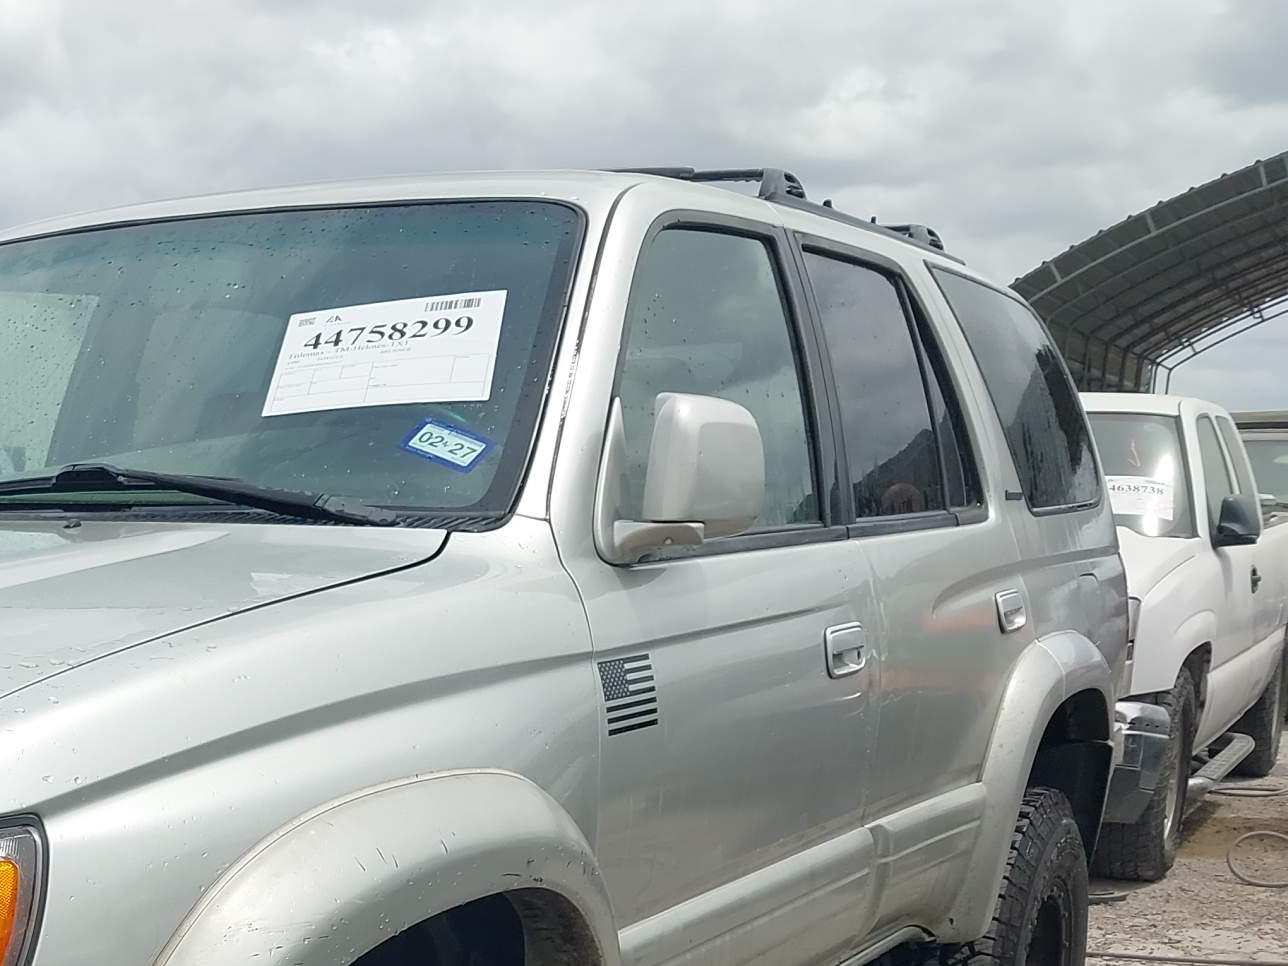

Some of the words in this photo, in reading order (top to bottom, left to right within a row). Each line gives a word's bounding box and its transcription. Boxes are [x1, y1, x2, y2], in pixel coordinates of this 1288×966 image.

[303, 315, 474, 350] 44758299
[418, 431, 445, 448] 02
[448, 443, 478, 458] 27
